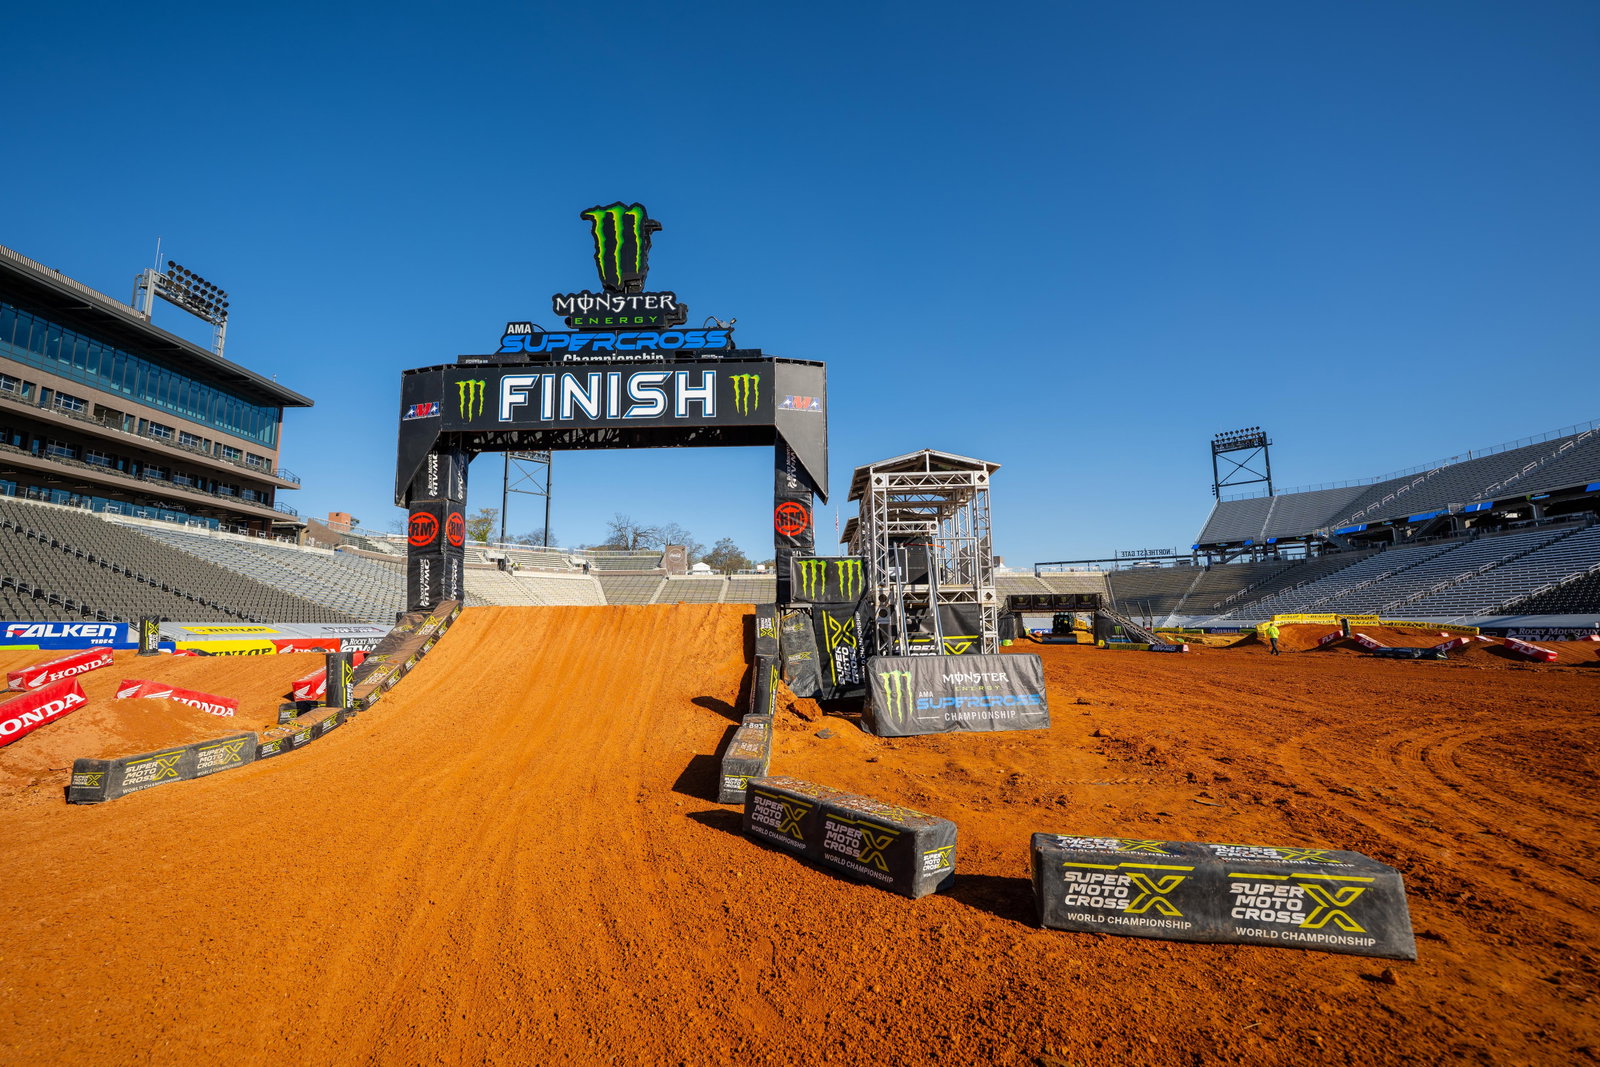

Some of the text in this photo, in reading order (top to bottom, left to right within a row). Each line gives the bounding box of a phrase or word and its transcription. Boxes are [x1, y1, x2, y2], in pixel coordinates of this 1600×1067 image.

[556, 293, 676, 314] MONSTER
[507, 324, 532, 334] AMA
[574, 316, 658, 325] ENERGY
[499, 330, 731, 353] SUPERCROSS
[499, 370, 717, 421] FINISH
[778, 395, 823, 413] AMA
[402, 401, 442, 421] AMA
[411, 521, 434, 533] RM
[4, 624, 118, 638] FALKEN
[1511, 643, 1538, 655] FLY
[835, 646, 846, 685] SUPER
[942, 671, 1009, 685] MONSTER
[916, 693, 1042, 710] SUPERCROSS
[0, 693, 86, 738] ONDA
[944, 711, 1017, 721] CHAMPIONSHIP
[124, 761, 158, 774] SUPER
[197, 760, 223, 769] CRO
[121, 774, 156, 786] CROSS
[125, 767, 157, 780] MOTO
[754, 796, 784, 812] SUPER
[754, 805, 782, 820] MOTO
[751, 812, 782, 828] CROSS
[751, 824, 806, 850] WORLD CHAMPIONSHIP
[824, 820, 863, 839] SUPER
[826, 831, 860, 849] MOTO
[823, 840, 861, 858] CROSS
[824, 852, 894, 883] WORLD CHAMPIONSHIP
[1064, 871, 1131, 887] SUPER
[1068, 883, 1129, 899] MOTO
[1229, 882, 1305, 899] SUPER
[1064, 894, 1130, 910] CROSS
[1235, 895, 1303, 912] MOTO
[1067, 912, 1192, 930] WORLD CHAMPIONSHIP
[1231, 907, 1306, 925] CROSS
[1235, 926, 1376, 947] WORLD CHAMPIONSHIP
